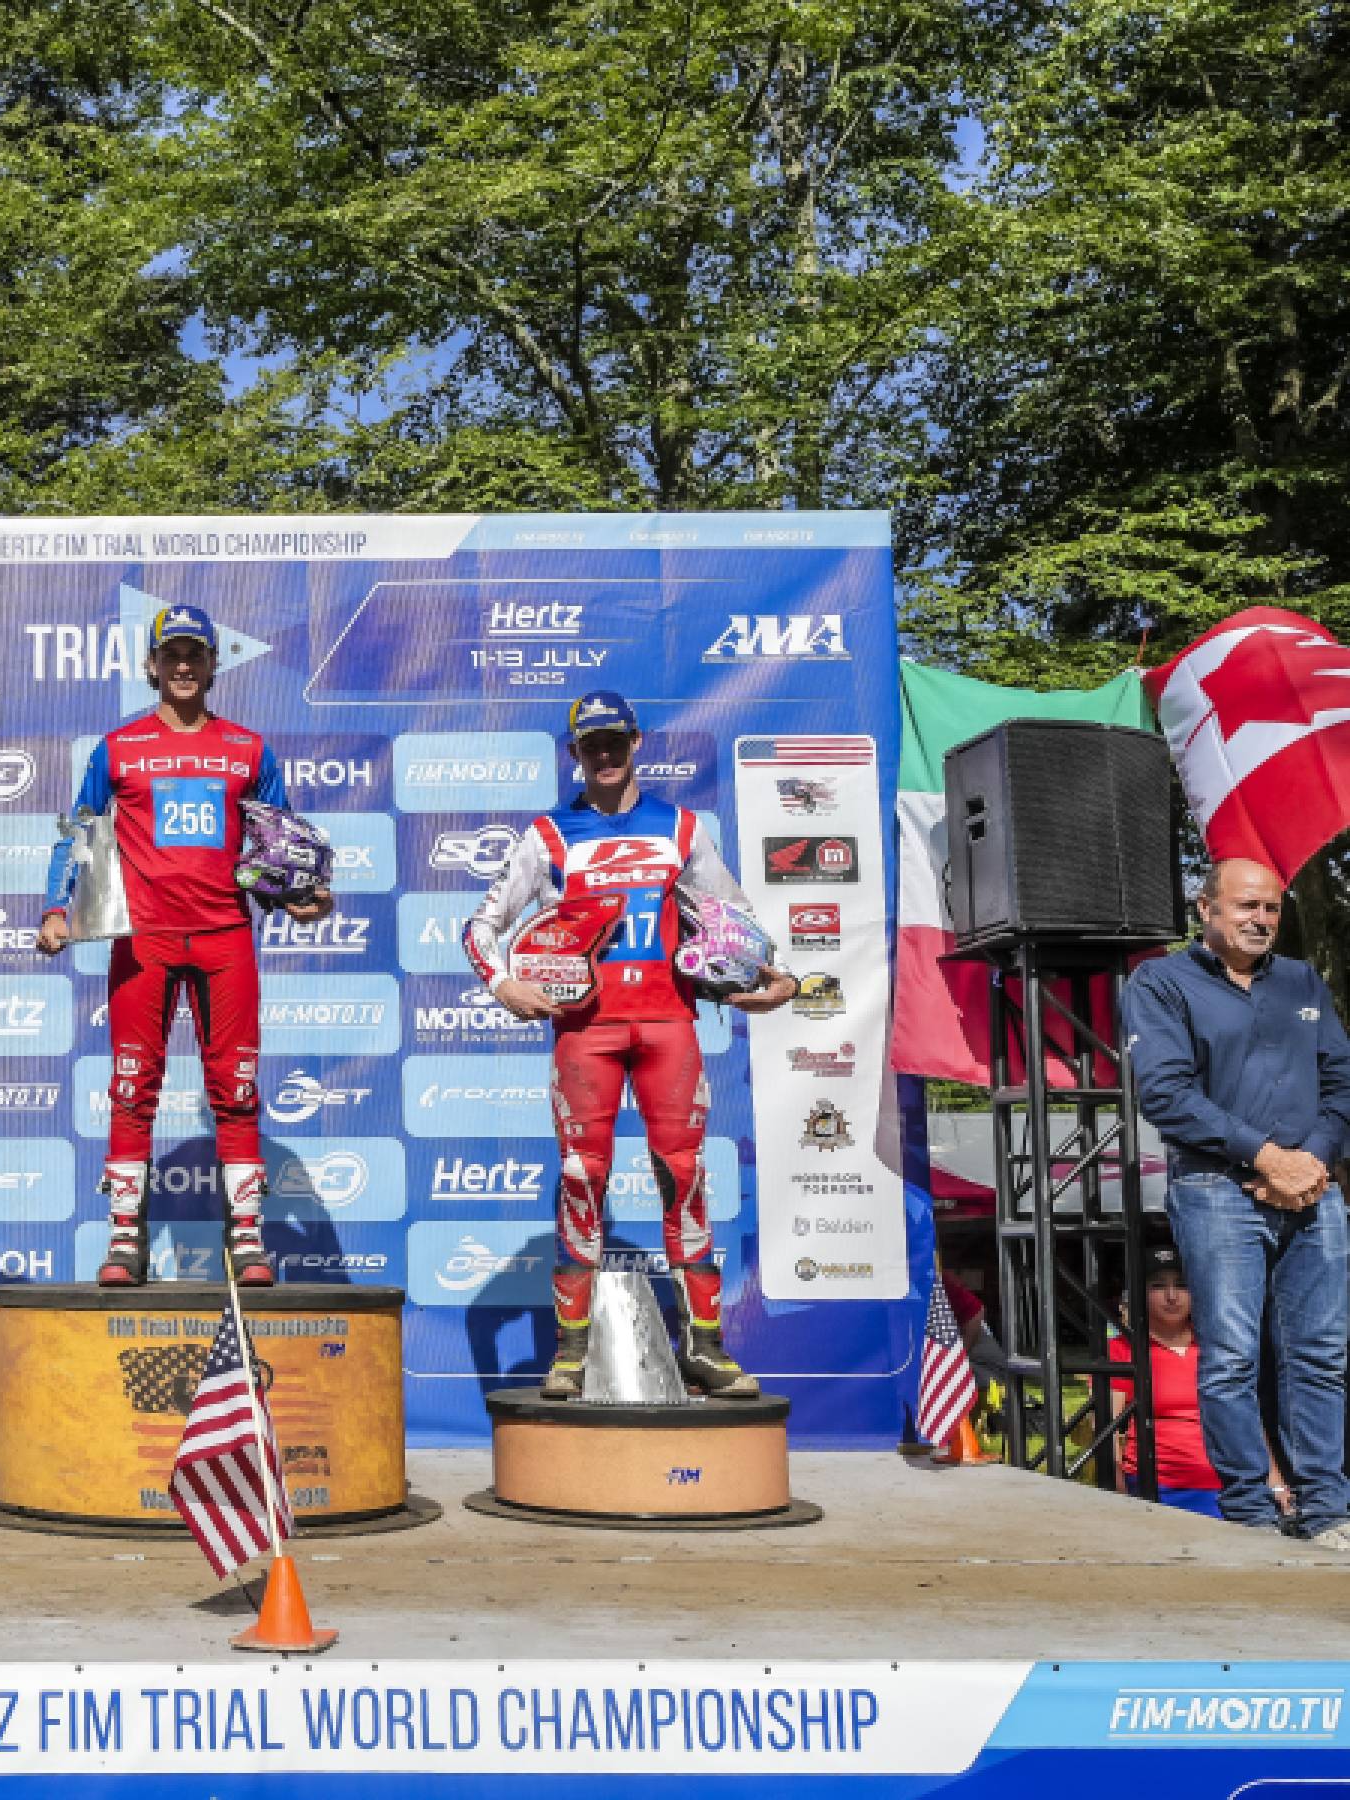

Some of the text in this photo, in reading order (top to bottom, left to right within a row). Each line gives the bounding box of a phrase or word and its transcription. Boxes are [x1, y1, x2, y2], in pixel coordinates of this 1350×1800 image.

[54, 534, 87, 557] FIM
[92, 534, 145, 556] TRIAL
[153, 533, 220, 555] WORLD
[225, 532, 367, 555] CHAMPIONSHIP
[491, 602, 583, 630] Hertz
[705, 614, 847, 656] AMA
[470, 649, 609, 668] 11-13 JULY
[509, 671, 566, 685] 2025
[119, 755, 250, 777] Honda
[284, 760, 373, 787] IROH
[404, 761, 540, 783] FIM-MOTO.TV
[162, 800, 217, 836] 256
[262, 914, 370, 945] Hertz
[609, 911, 657, 949] 17
[261, 1004, 385, 1024] IM-MOTO.TV
[434, 1157, 544, 1192] Hertz
[38, 1689, 122, 1752] FIM
[140, 1688, 284, 1751] TRIAL
[302, 1688, 480, 1750] WORLD
[497, 1687, 880, 1752] CHAMPIONSHIP
[1108, 1695, 1342, 1731] FIM-MOTO.TV
